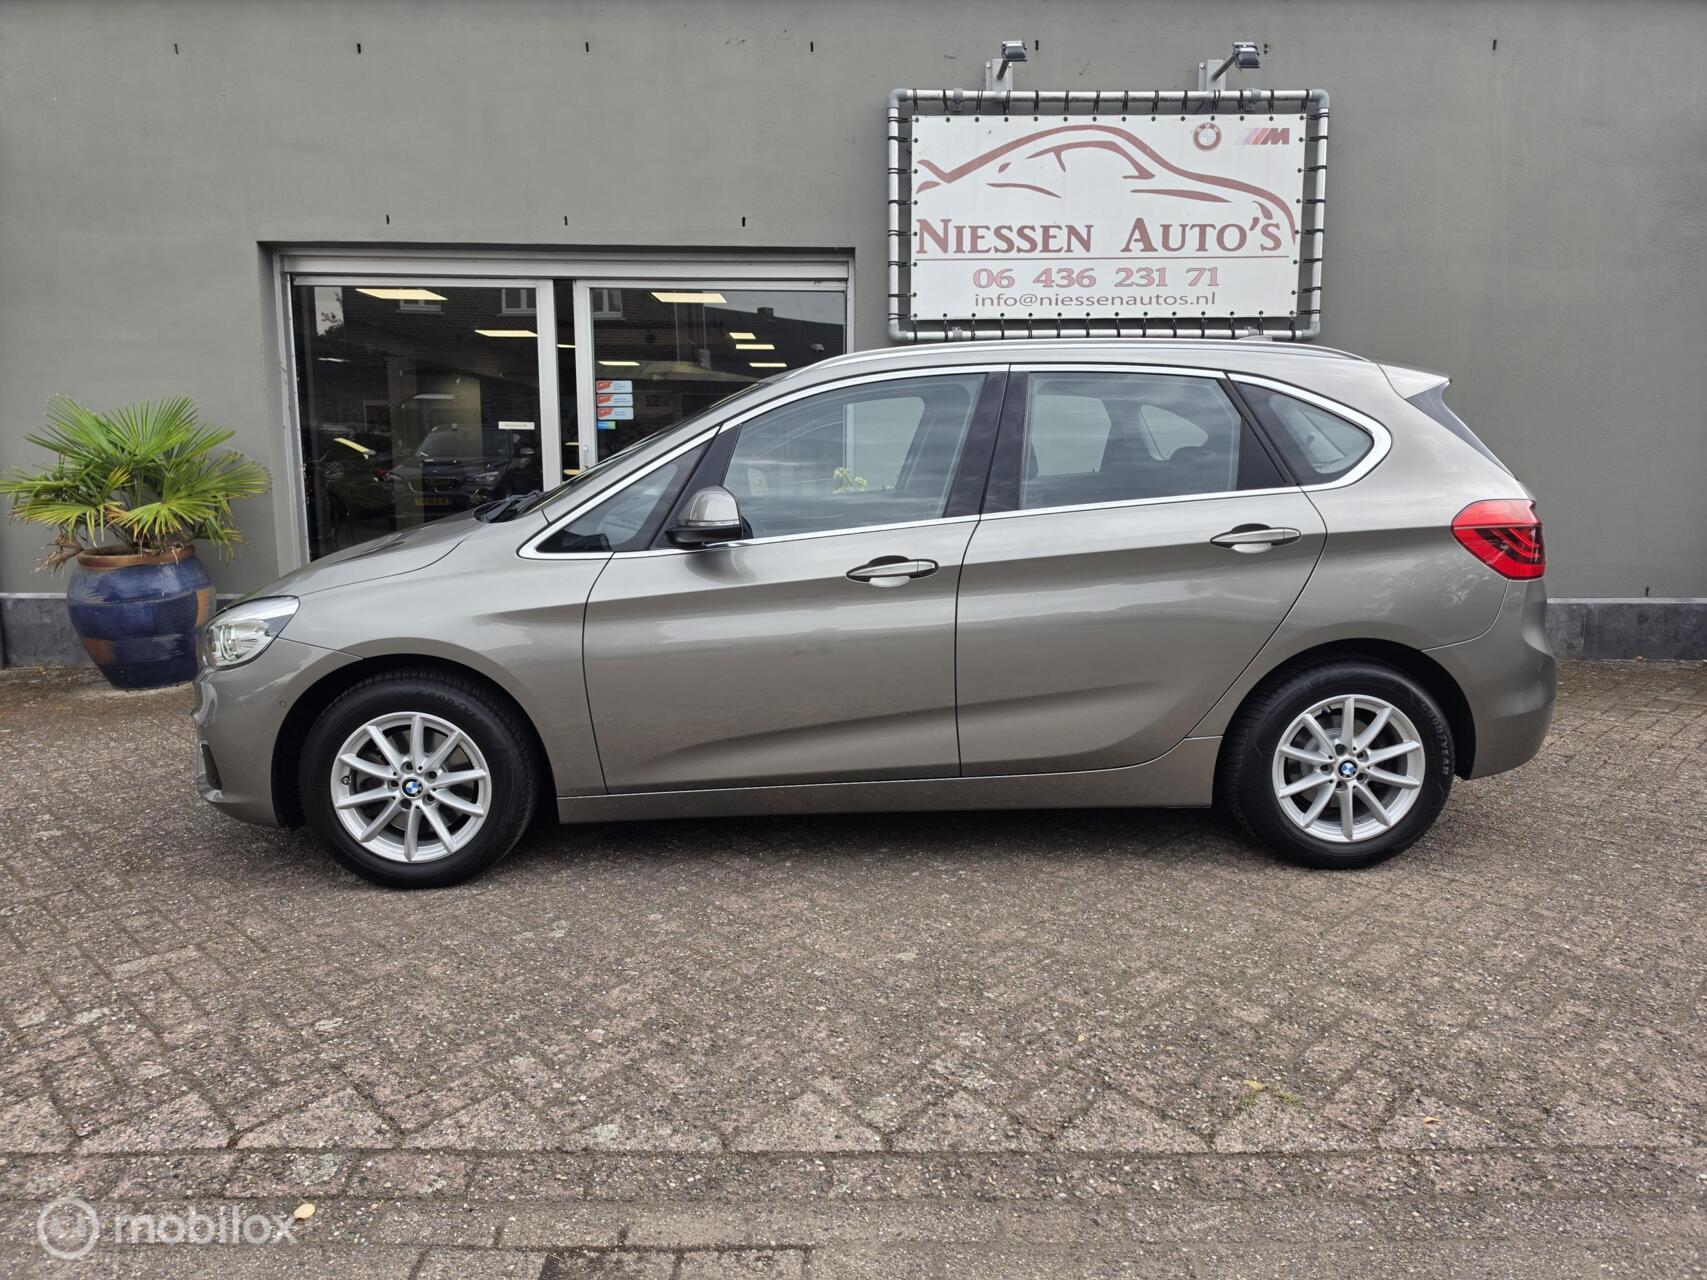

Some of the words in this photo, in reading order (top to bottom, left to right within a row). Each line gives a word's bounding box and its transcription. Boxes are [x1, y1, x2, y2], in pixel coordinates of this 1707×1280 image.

[972, 268, 1016, 288] 06
[1032, 267, 1097, 288] 436
[1114, 266, 1168, 287] 231
[1185, 266, 1220, 287] 71
[974, 292, 1216, 307] info@niessenautos.nl
